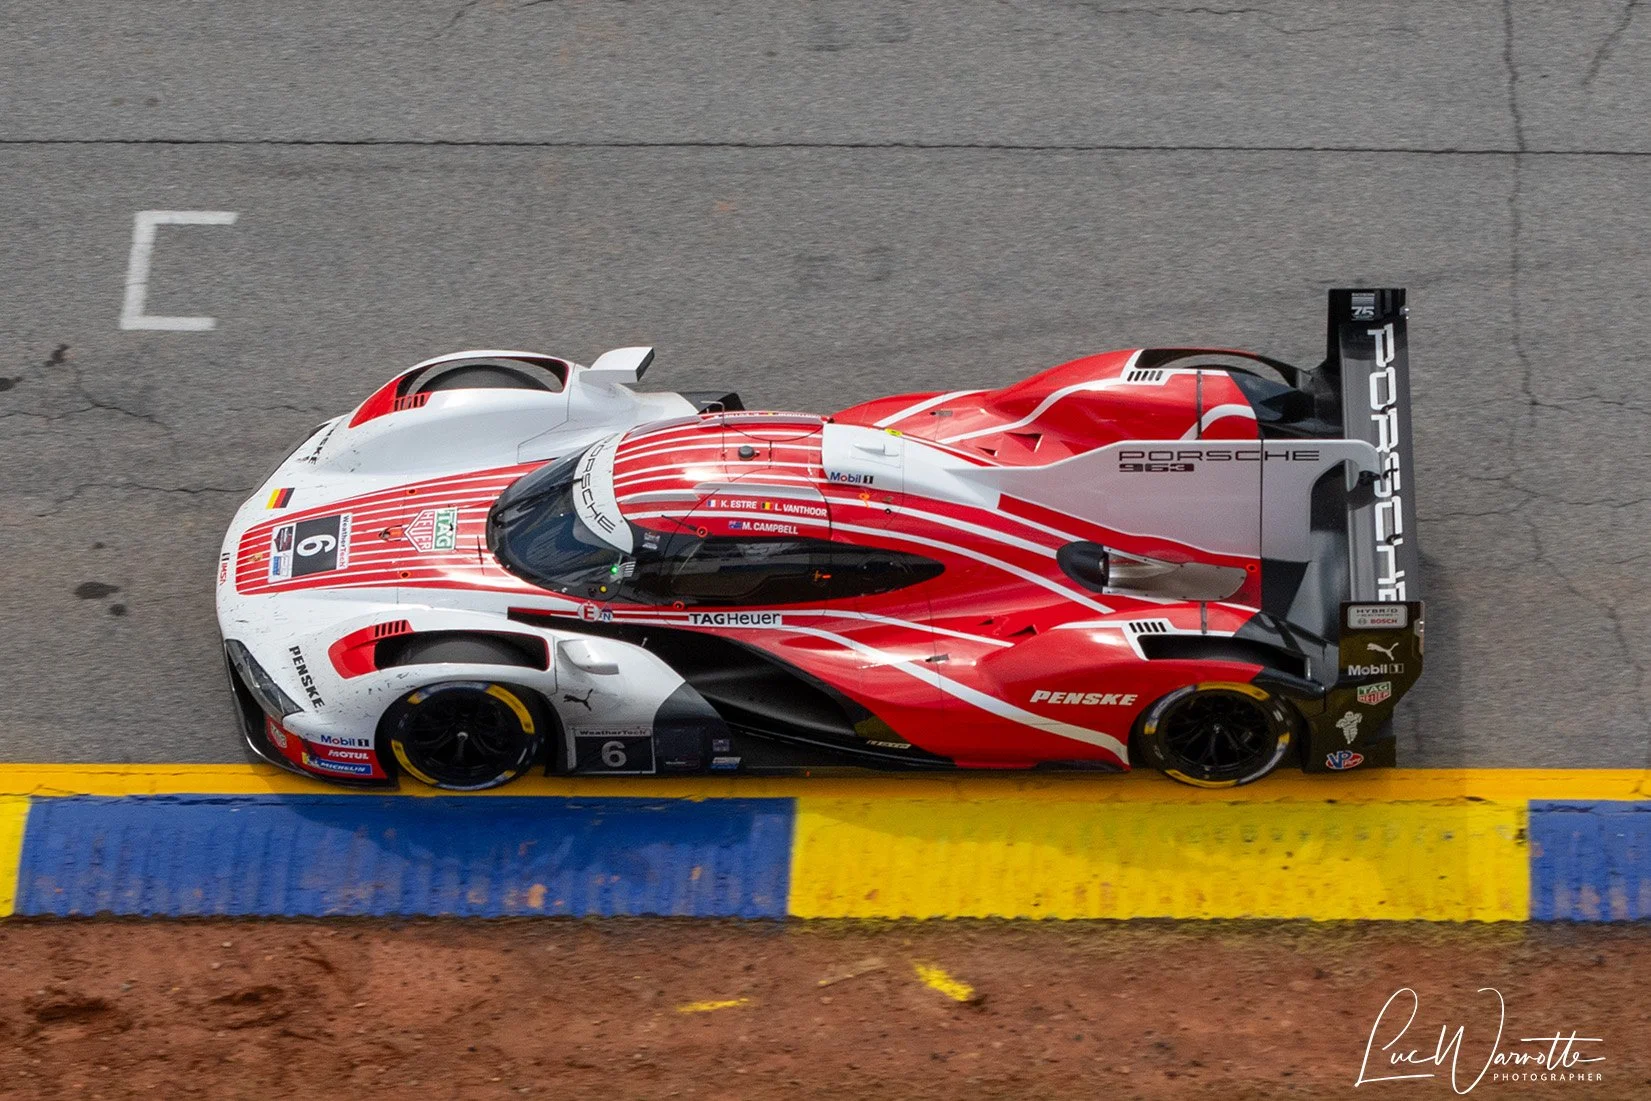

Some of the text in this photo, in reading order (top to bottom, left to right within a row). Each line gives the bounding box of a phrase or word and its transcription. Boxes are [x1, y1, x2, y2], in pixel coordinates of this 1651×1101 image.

[1351, 306, 1375, 316] 75
[1119, 450, 1320, 461] PORSCHE
[1119, 463, 1195, 473] 963
[830, 472, 862, 484] Mobil
[720, 501, 757, 510] K. ESTRE
[774, 503, 828, 517] L. VANTHOOR
[410, 511, 434, 550] HEUER
[436, 512, 453, 548] TAG
[741, 522, 799, 535] M. CAMPBELL
[296, 533, 337, 557] 6
[340, 515, 350, 567] WeatherTech
[1348, 664, 1388, 676] Mobil
[289, 645, 325, 709] PENSKE
[1361, 685, 1388, 695] TAG
[1030, 690, 1138, 706] PENSKE
[320, 734, 356, 746] Mobil
[328, 749, 369, 760] MOTUL
[601, 740, 627, 767] 6
[320, 761, 366, 773] MICHELIN
